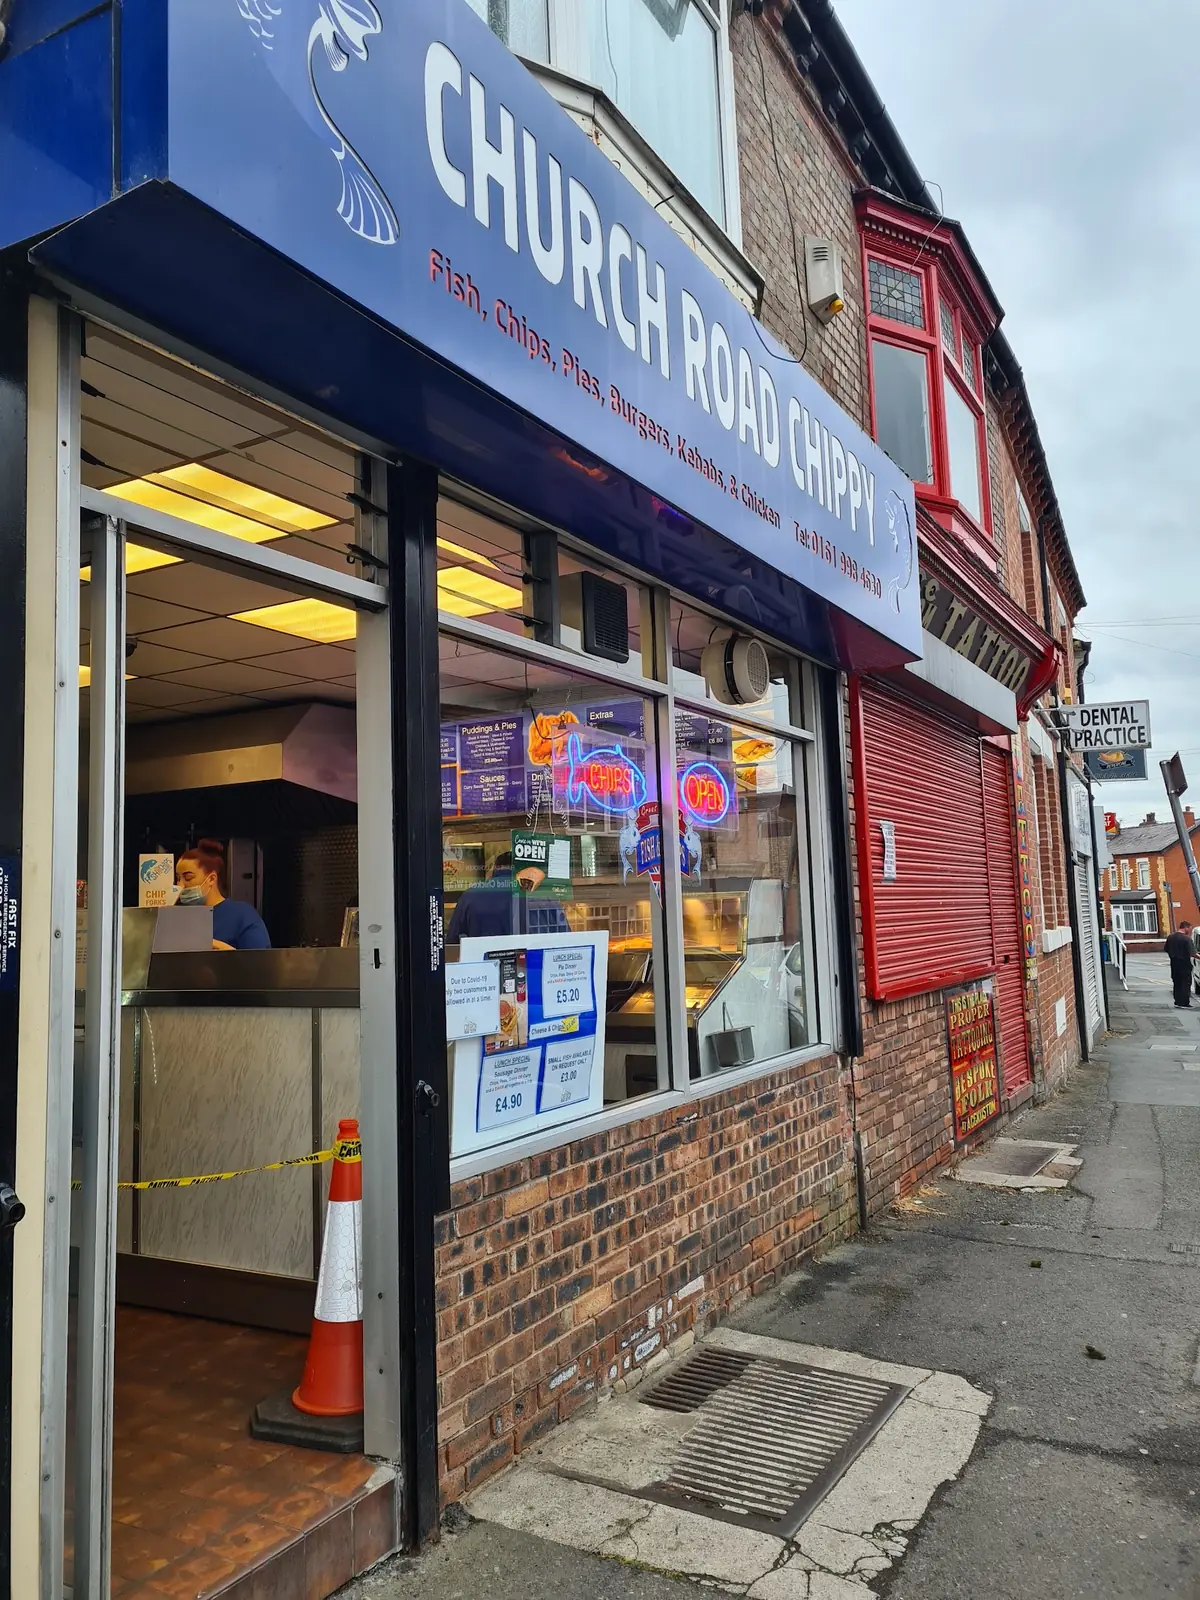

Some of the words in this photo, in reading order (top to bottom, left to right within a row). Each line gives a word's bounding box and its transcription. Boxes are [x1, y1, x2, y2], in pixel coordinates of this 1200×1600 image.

[424, 40, 671, 381] CHURCH
[681, 288, 781, 468] ROAD
[789, 396, 876, 547] CHIPPY
[428, 249, 488, 322] Fish,
[494, 299, 557, 372] Chips,
[562, 348, 606, 407] Pies,
[609, 384, 674, 456] Burgers,
[677, 434, 727, 493] Kebabs,
[730, 475, 739, 500] &
[741, 484, 781, 530] Chicken
[840, 551, 859, 583] 998
[940, 596, 1031, 693] TATTOO
[589, 711, 614, 720] Extras
[1080, 706, 1139, 727] DENTAL
[462, 725, 493, 735] Puddings
[495, 723, 500, 731] &
[501, 722, 517, 730] Pies
[1074, 726, 1146, 747] PRACTICE
[479, 774, 506, 784] Sauces
[590, 763, 631, 794] CHIPS
[686, 775, 724, 812] OPEN
[641, 805, 658, 816] Great
[515, 844, 545, 859] OPEN
[641, 836, 656, 864] FISH
[146, 890, 167, 898] CHIP
[8, 899, 17, 928] FAST
[8, 930, 16, 948] FIX
[566, 953, 583, 961] SPECIAL
[467, 975, 487, 984] Covid-19
[463, 986, 487, 994] customers
[557, 988, 580, 1003] £5.20
[950, 1003, 990, 1030] PROPER
[531, 1026, 547, 1036] Cheese
[951, 1020, 993, 1060] TATTOOING
[494, 1059, 511, 1068] LUNCH
[512, 1055, 530, 1064] SPECIAL
[547, 1056, 562, 1064] SMALL
[572, 1049, 591, 1058] AVAILABLE
[559, 1060, 577, 1069] REQUEST
[494, 1069, 513, 1078] Sausage
[560, 1070, 577, 1082] £3.00
[955, 1058, 996, 1101] BESPOKE
[495, 1092, 522, 1112] £4.90
[960, 1079, 994, 1115] FOLK
[147, 1180, 180, 1188] CAUTION
